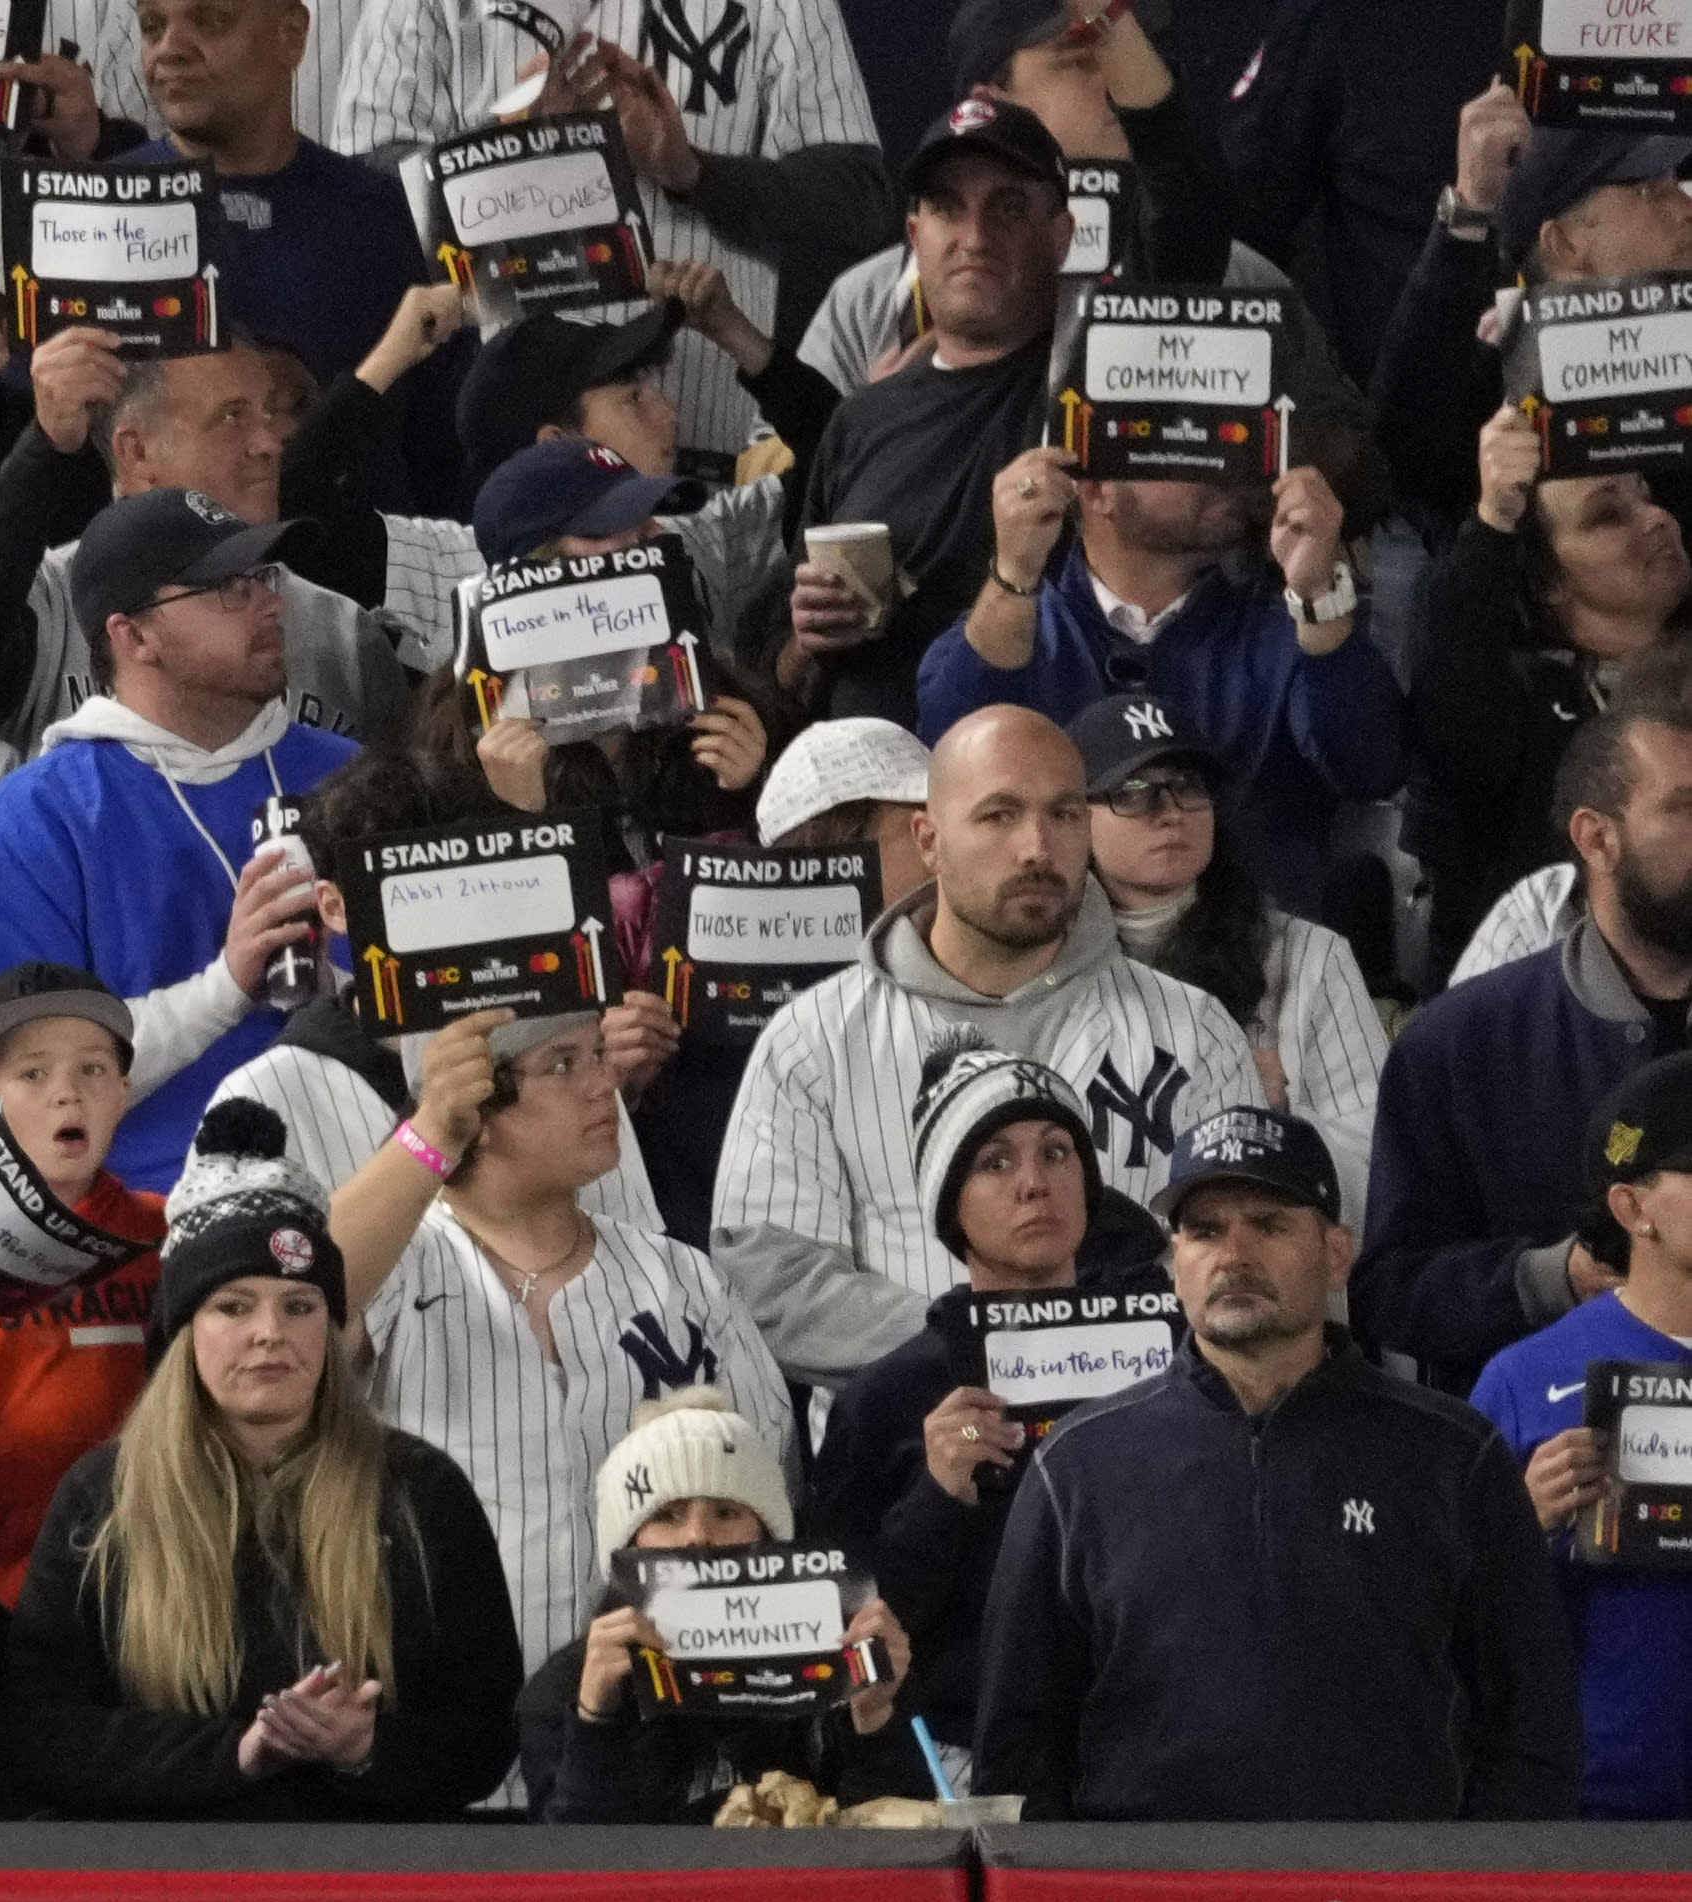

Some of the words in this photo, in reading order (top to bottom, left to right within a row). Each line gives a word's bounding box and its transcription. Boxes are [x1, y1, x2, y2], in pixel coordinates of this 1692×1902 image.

[22, 170, 30, 194] I
[37, 172, 109, 198] STAND
[115, 176, 151, 199] UP
[159, 170, 203, 197] FOR
[38, 218, 86, 242] Those
[92, 228, 107, 241] in
[112, 217, 145, 241] the
[127, 233, 195, 264] FIGHT
[1076, 294, 1086, 317] I
[1093, 294, 1179, 319] STAND
[1186, 297, 1223, 320] UP
[1230, 299, 1281, 323] FOR
[1158, 334, 1195, 356] MY
[1104, 365, 1250, 393] COMMUNITY
[481, 563, 563, 600] STAND
[570, 556, 605, 577] UP
[613, 547, 665, 571] FOR
[489, 616, 549, 640] Those
[554, 609, 571, 622] in
[576, 593, 609, 616] the
[592, 602, 659, 637] FIGHT
[363, 849, 373, 872] I
[380, 837, 469, 869] STAND
[475, 831, 513, 857] UP
[520, 823, 575, 851] FOR
[683, 853, 692, 877] I
[698, 855, 783, 882] STAND
[790, 858, 822, 882] UP
[827, 855, 865, 879] FOR
[694, 912, 748, 938] THOSE
[758, 910, 815, 939] WE'VE
[824, 912, 859, 937] LOST
[969, 1304, 979, 1326] I
[986, 1300, 1073, 1324] STAND
[1080, 1296, 1118, 1318] UP
[1126, 1293, 1180, 1316] FOR
[990, 1356, 1037, 1379] Kids
[1041, 1360, 1067, 1376] in
[1068, 1350, 1108, 1374] the
[1111, 1346, 1171, 1378] Fight
[637, 1560, 647, 1585] I
[655, 1559, 741, 1585] STAND
[747, 1555, 785, 1580] UP
[792, 1549, 847, 1576] FOR
[724, 1595, 761, 1621] MY
[677, 1620, 822, 1651] COMMUNITY
